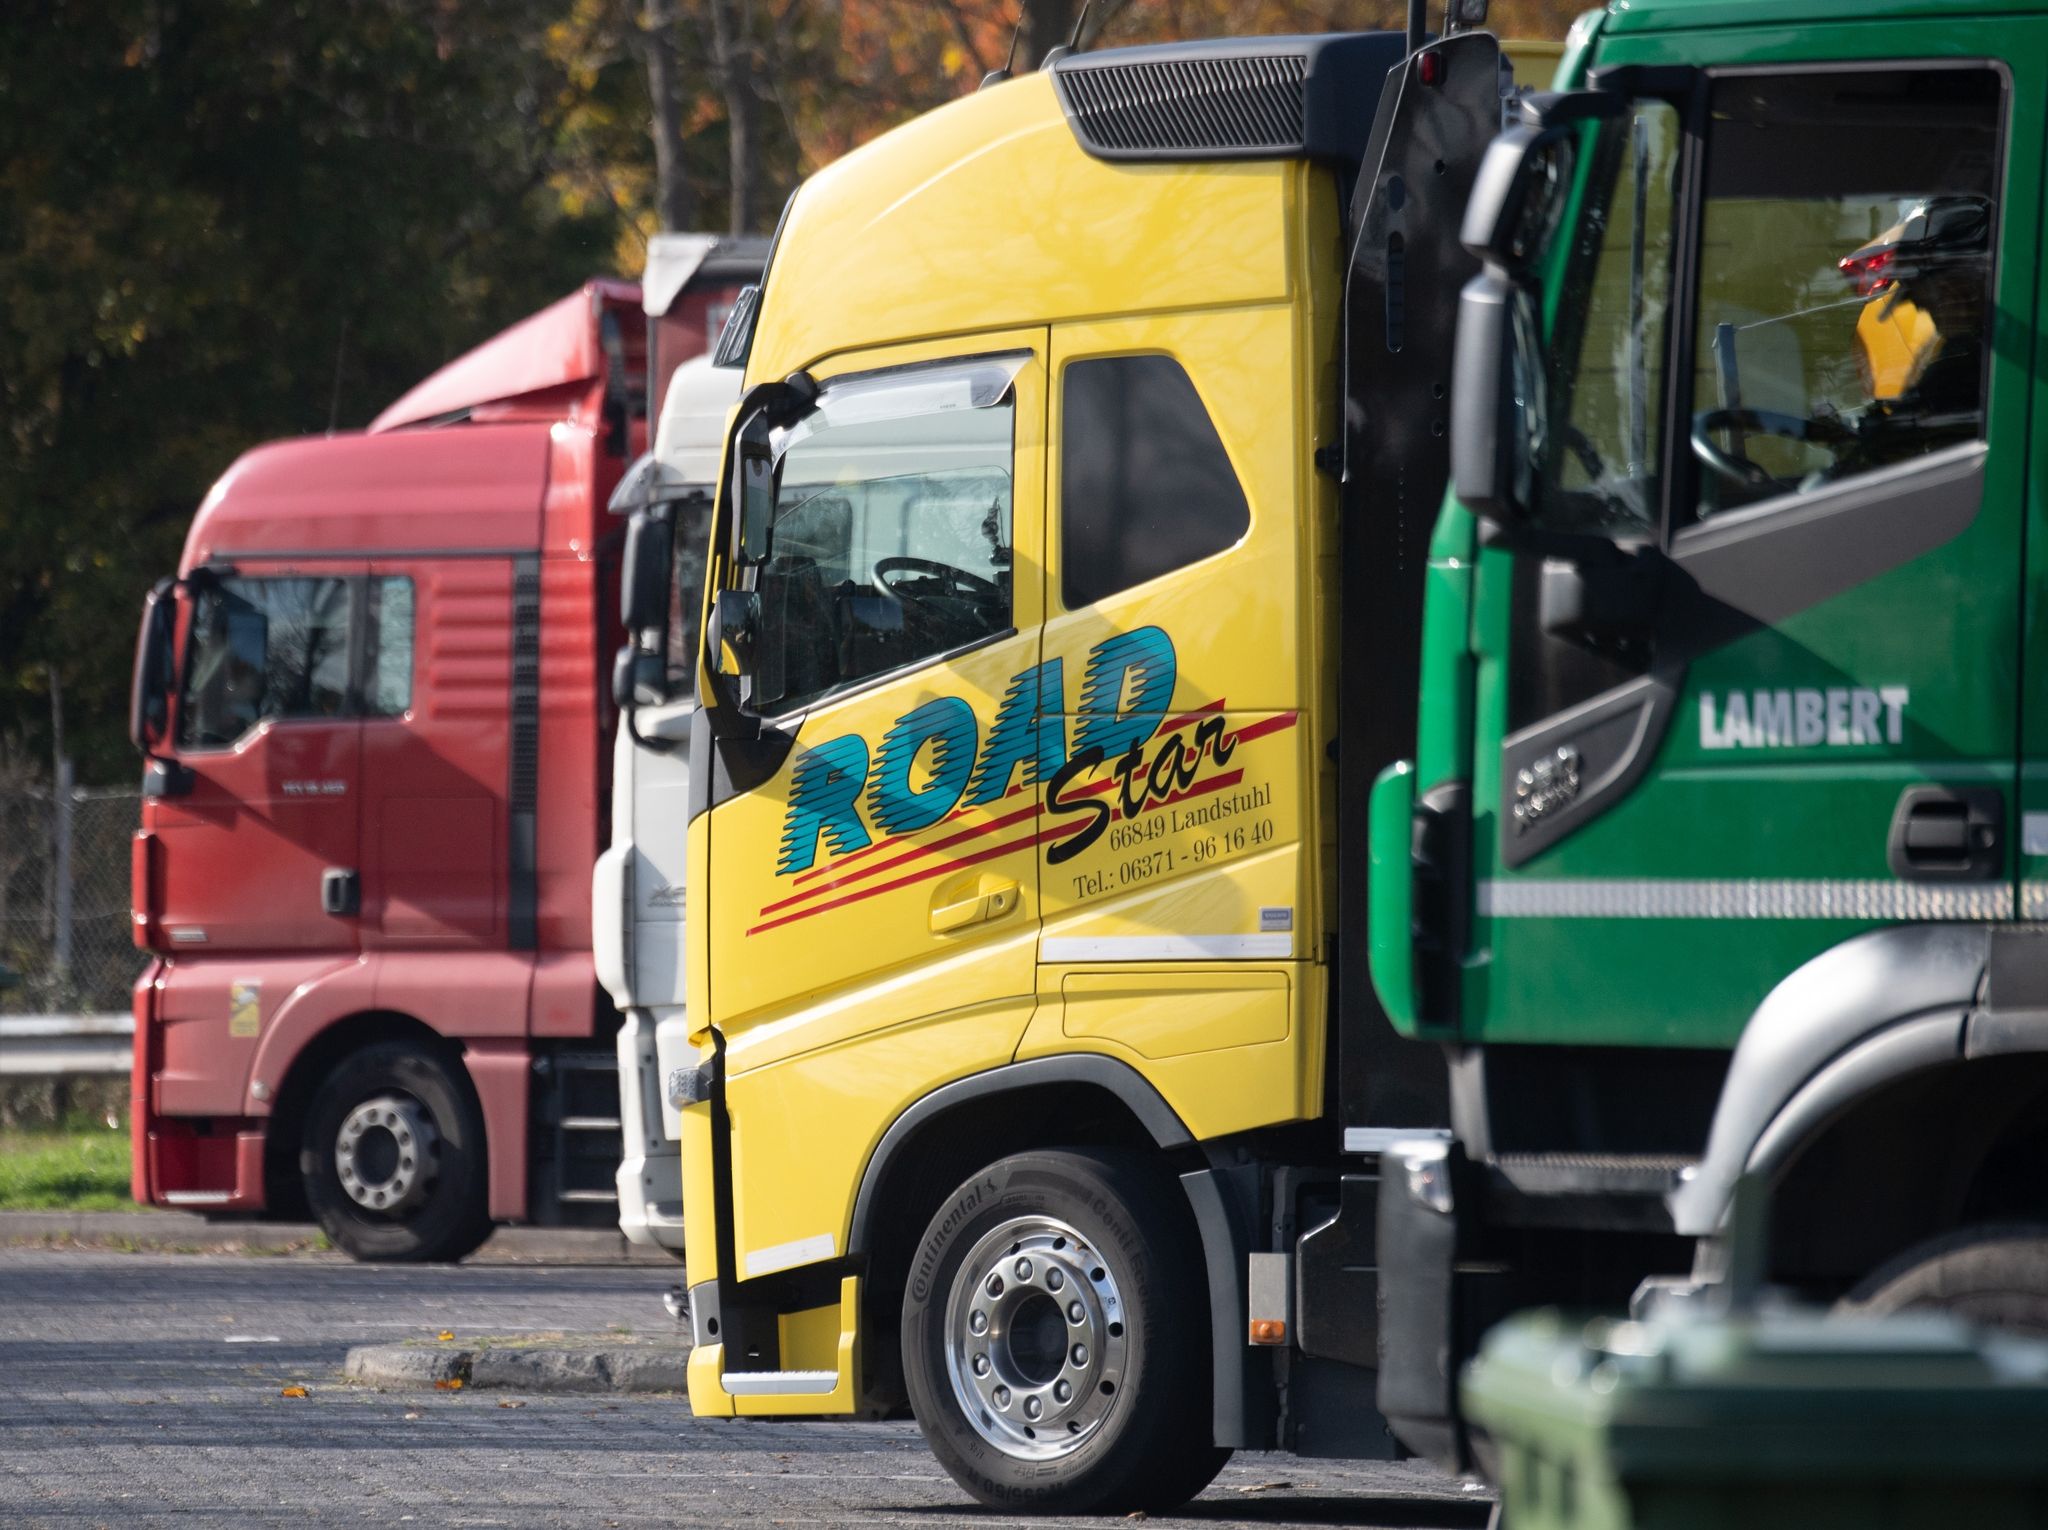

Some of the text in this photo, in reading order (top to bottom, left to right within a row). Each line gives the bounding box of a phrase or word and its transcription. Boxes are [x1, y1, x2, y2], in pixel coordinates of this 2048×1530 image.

[776, 625, 1177, 876] ROAD
[1701, 687, 1909, 749] LAMBERT
[1046, 716, 1237, 866] Star
[1110, 783, 1272, 852] 66849 Landstuhl
[1073, 871, 1115, 898] Tel.:
[1120, 849, 1175, 885] 06371
[1194, 836, 1217, 862] 96
[1224, 828, 1245, 854] 16
[1250, 818, 1274, 846] 40
[912, 1184, 983, 1303] Continental
